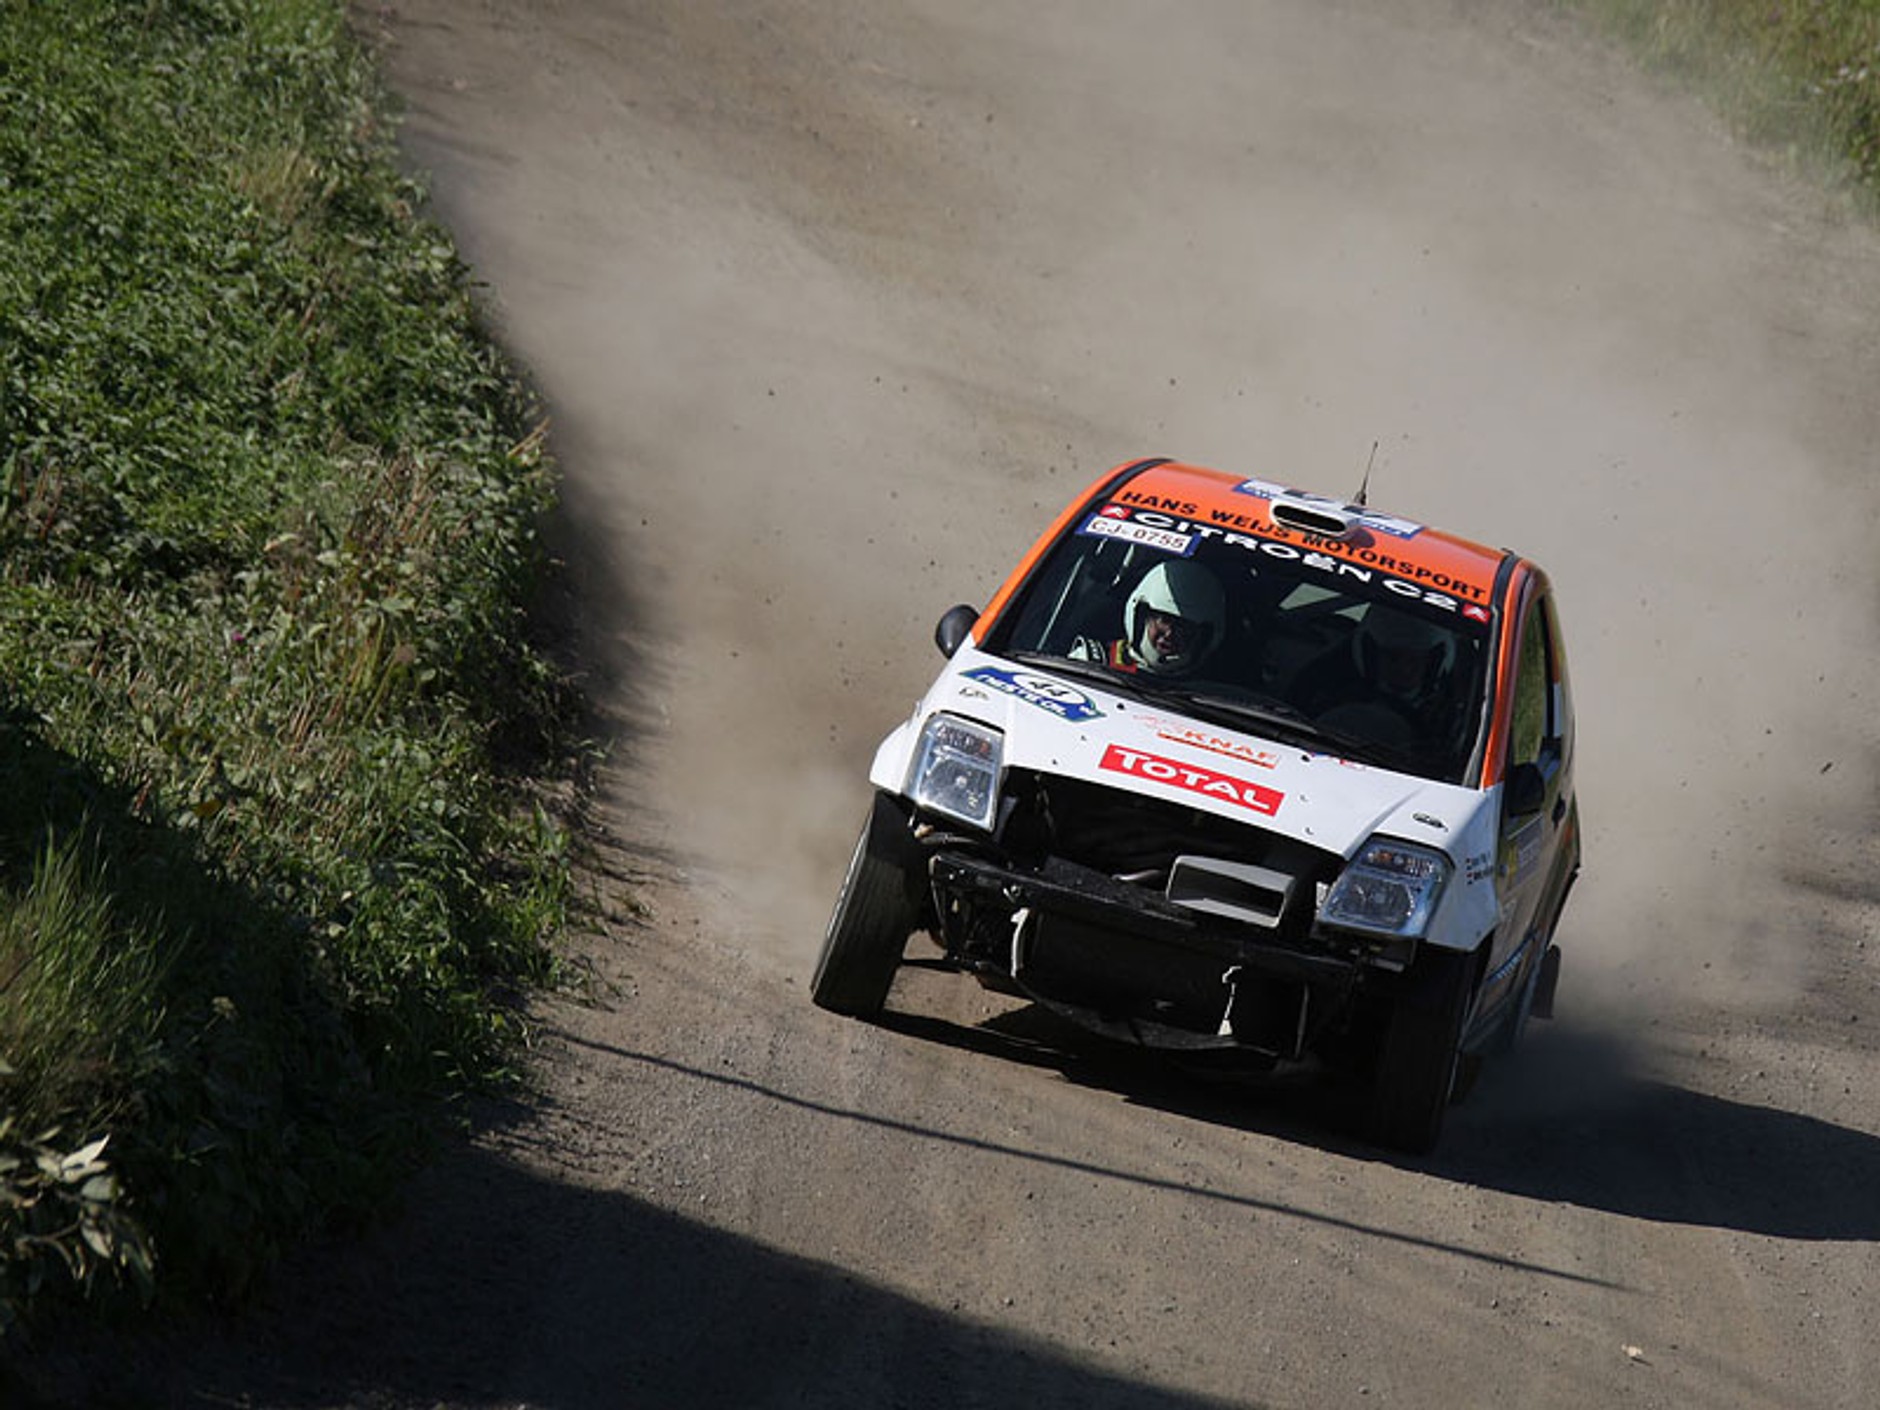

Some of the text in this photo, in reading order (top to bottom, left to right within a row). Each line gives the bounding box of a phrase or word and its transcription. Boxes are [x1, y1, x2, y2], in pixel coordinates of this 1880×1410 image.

[1122, 490, 1486, 599] HANS WEIJS MOTORSPORT
[1134, 512, 1459, 612] CITROËN C2
[1112, 748, 1273, 811] TOTAL
